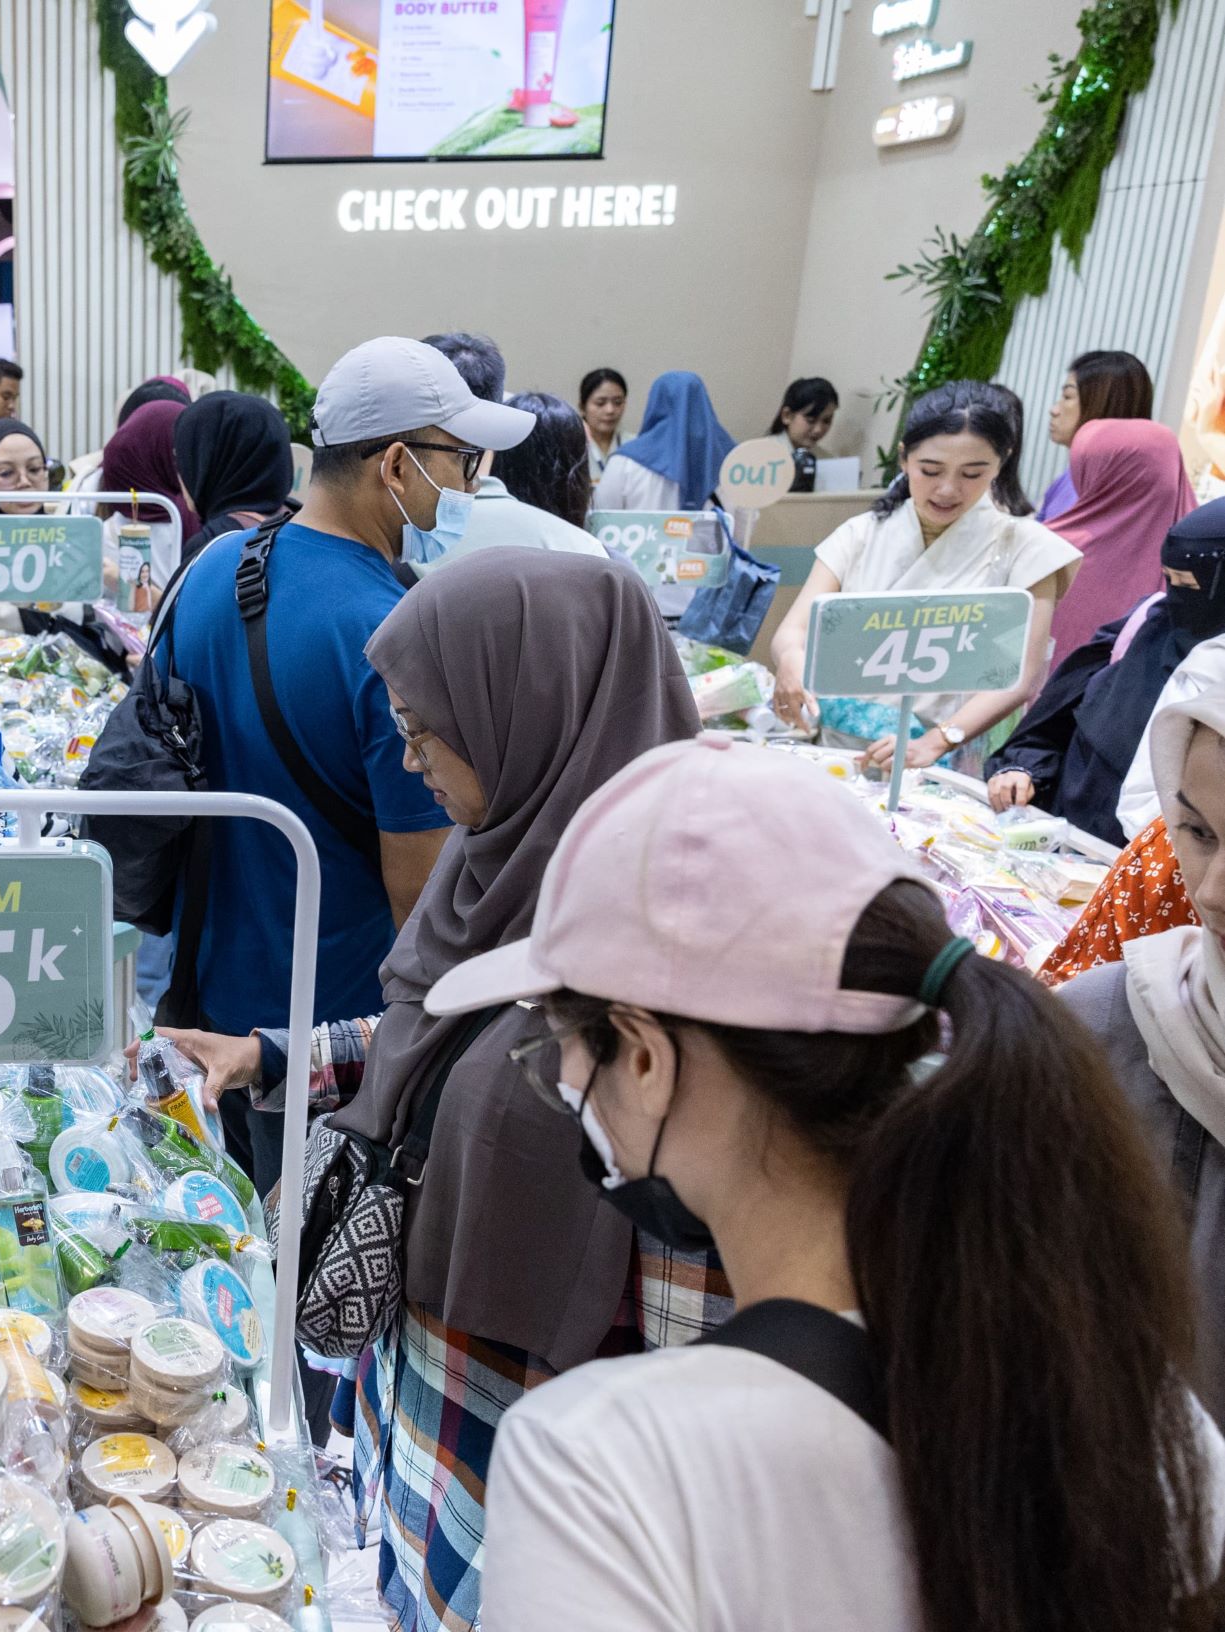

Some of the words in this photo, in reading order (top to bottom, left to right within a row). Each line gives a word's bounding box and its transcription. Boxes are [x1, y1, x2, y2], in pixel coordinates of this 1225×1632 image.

[394, 1, 436, 15] BODY
[441, 1, 498, 15] BUTTER
[337, 188, 469, 233] CHECK
[474, 186, 557, 230] OUT
[560, 184, 678, 229] HERE!
[10, 526, 67, 545] ITEMS
[862, 610, 909, 632] ALL
[912, 603, 985, 627] ITEMS
[113, 1468, 153, 1479] Herborist
[101, 1529, 121, 1577] Herborist
